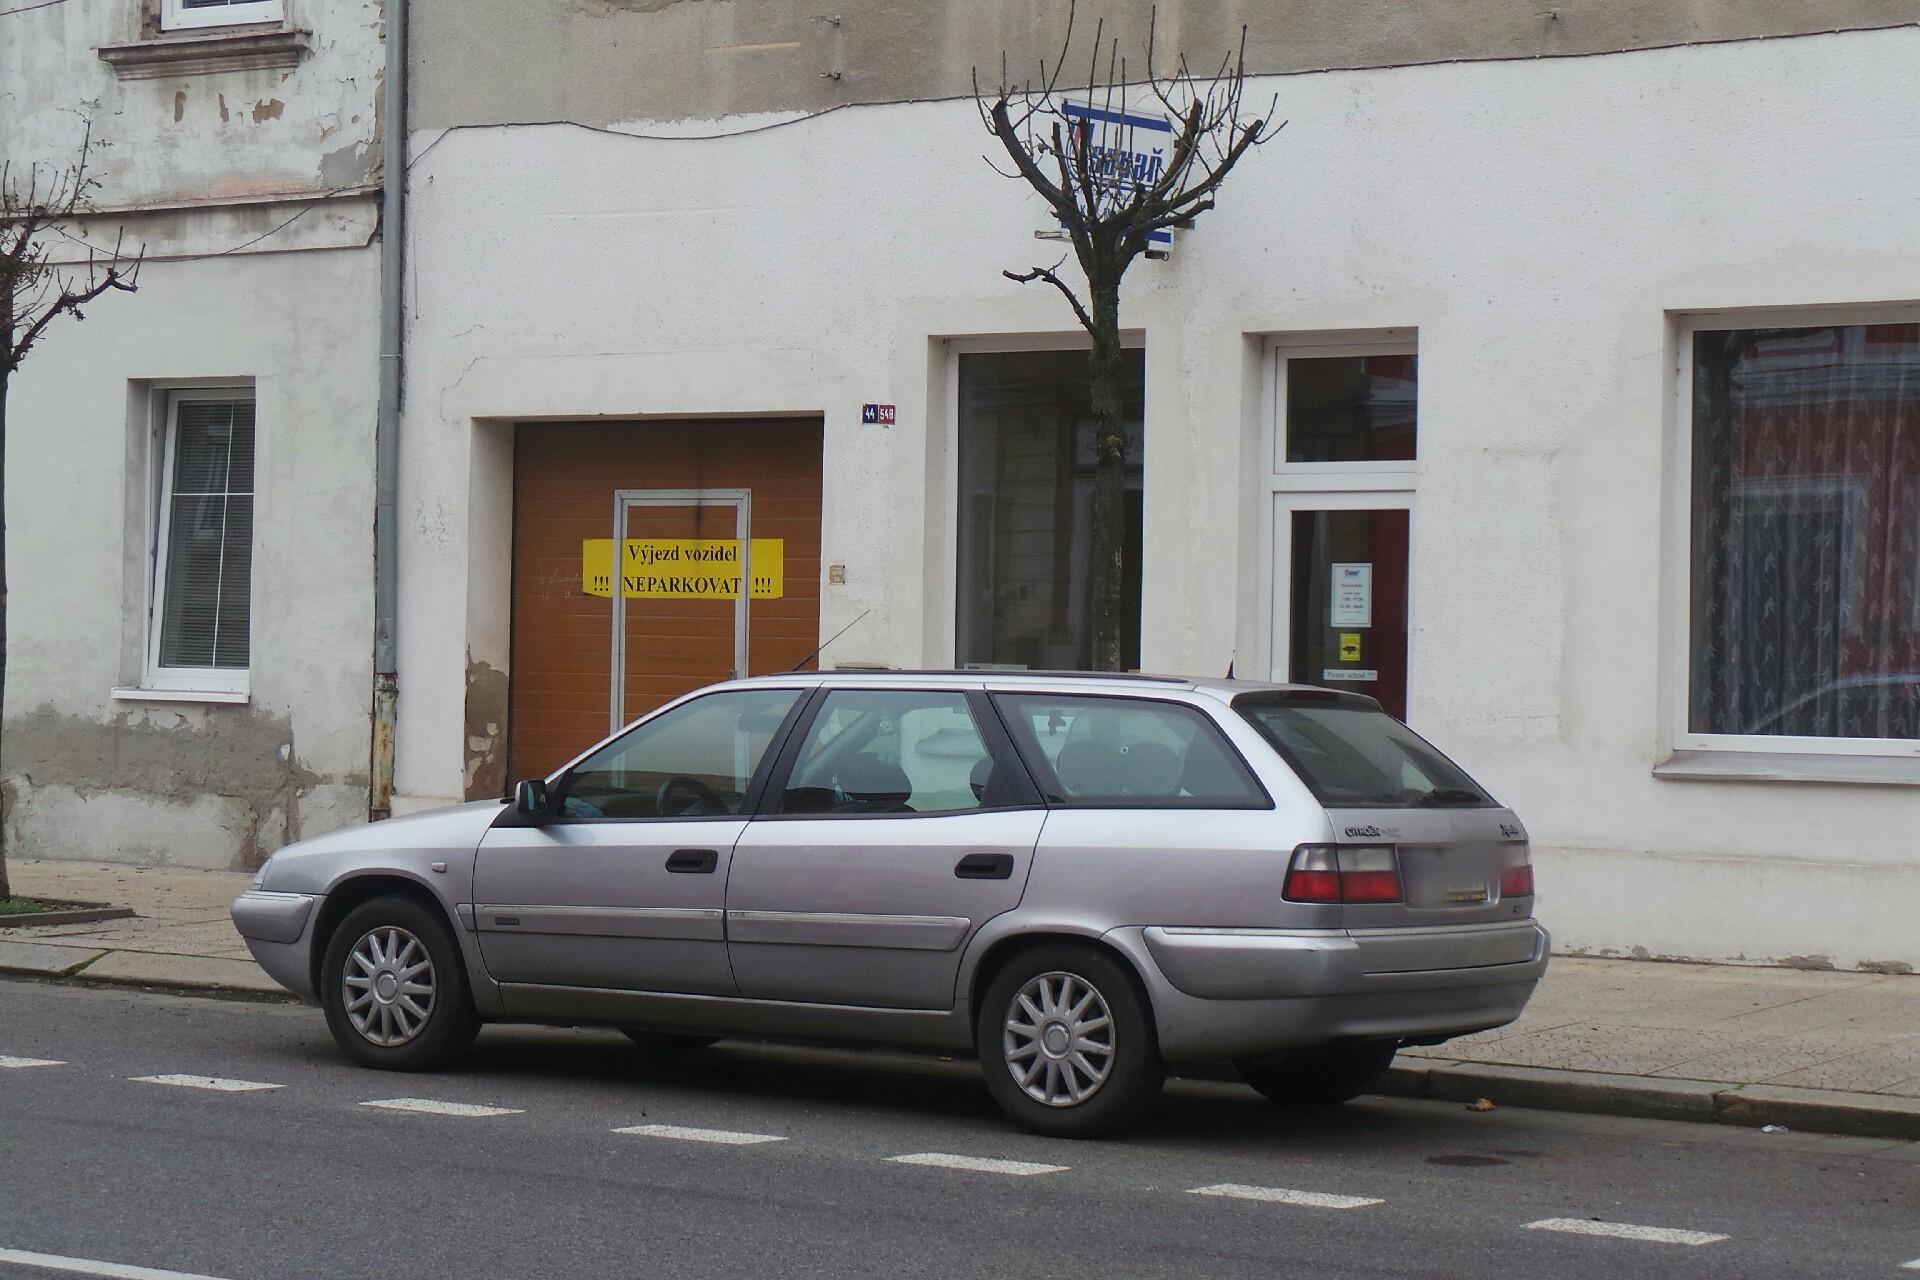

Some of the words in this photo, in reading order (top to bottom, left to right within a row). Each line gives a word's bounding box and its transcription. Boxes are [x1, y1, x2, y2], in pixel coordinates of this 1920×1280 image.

[865, 408, 875, 420] 44
[629, 545, 679, 565] Výjezd
[685, 545, 737, 561] vozidel
[593, 576, 609, 592] !!!
[623, 576, 742, 594] NEPARKOVAT
[755, 577, 771, 593] !!!
